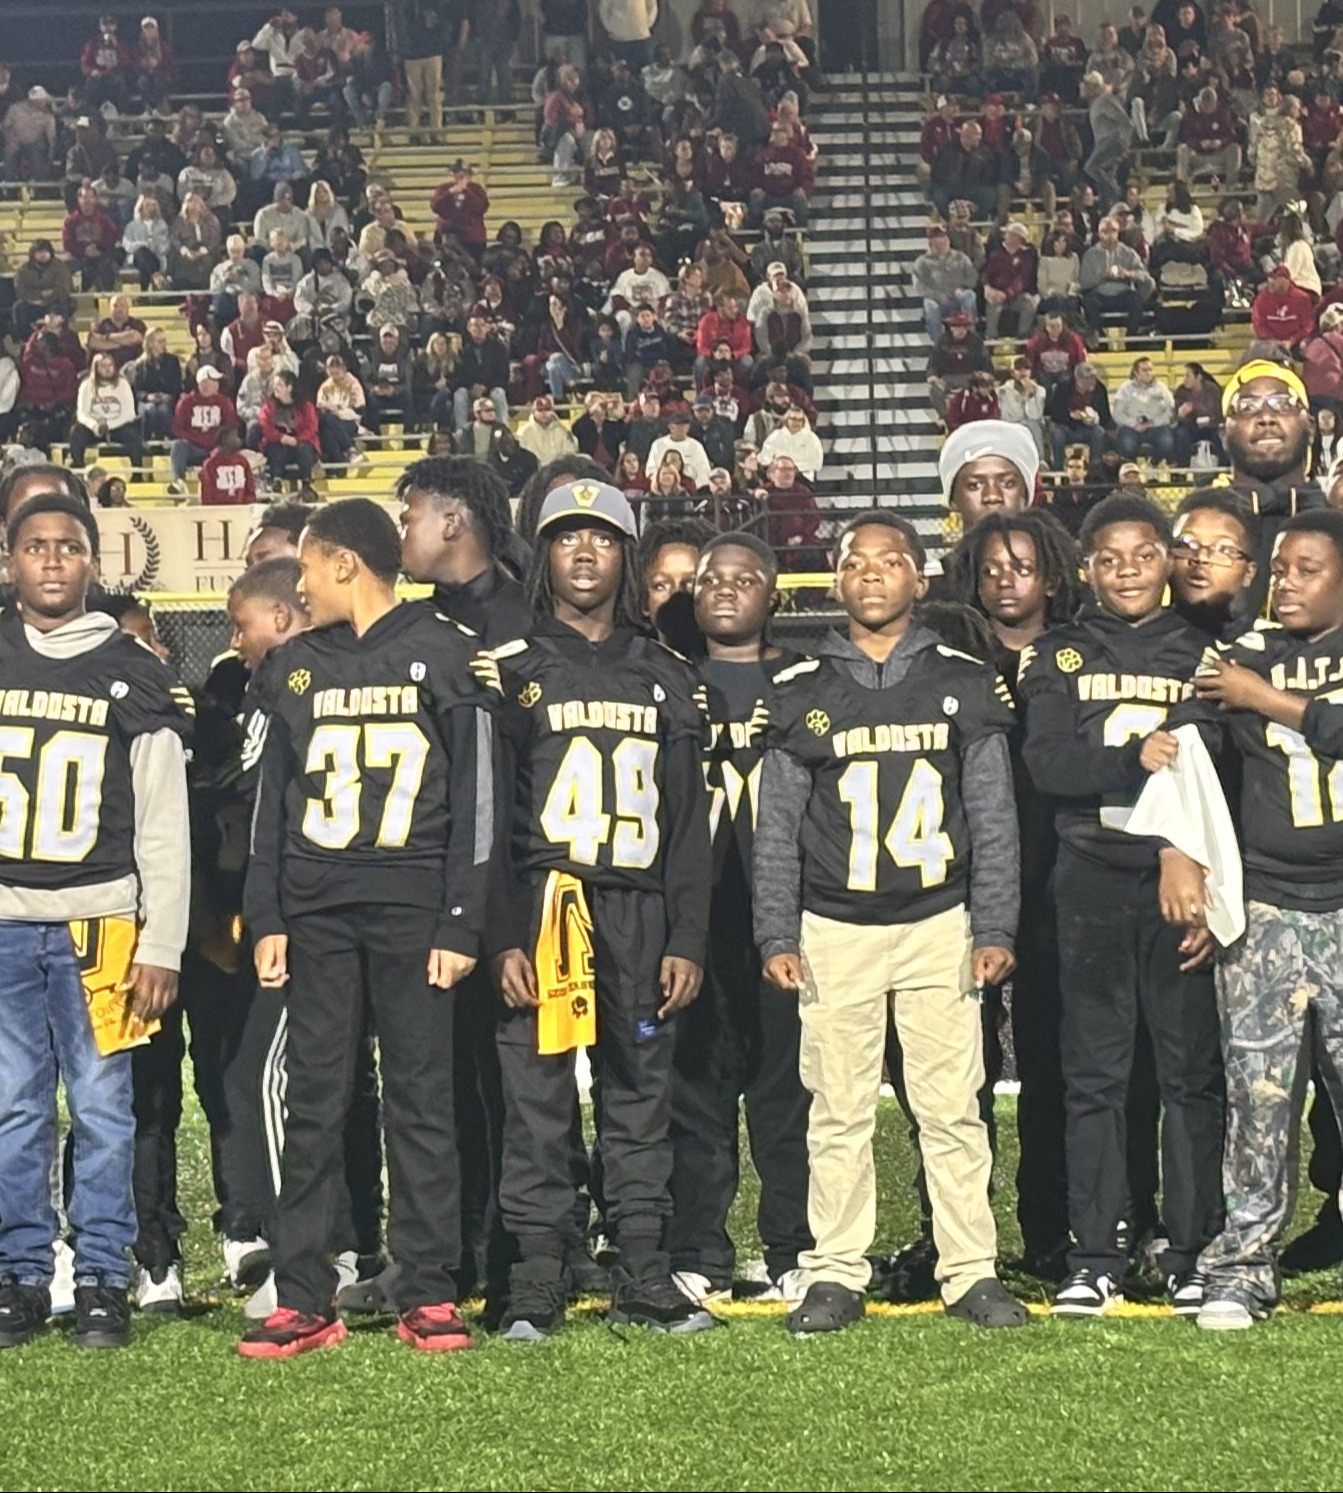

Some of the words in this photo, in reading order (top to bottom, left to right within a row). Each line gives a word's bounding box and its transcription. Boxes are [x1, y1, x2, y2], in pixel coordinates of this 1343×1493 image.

[313, 685, 418, 719] VALDOSTA
[547, 700, 658, 734] VALDOSTA
[832, 722, 949, 758] VALDOSTA
[302, 721, 431, 850] 37
[539, 735, 659, 869] 49
[837, 757, 955, 892] 14
